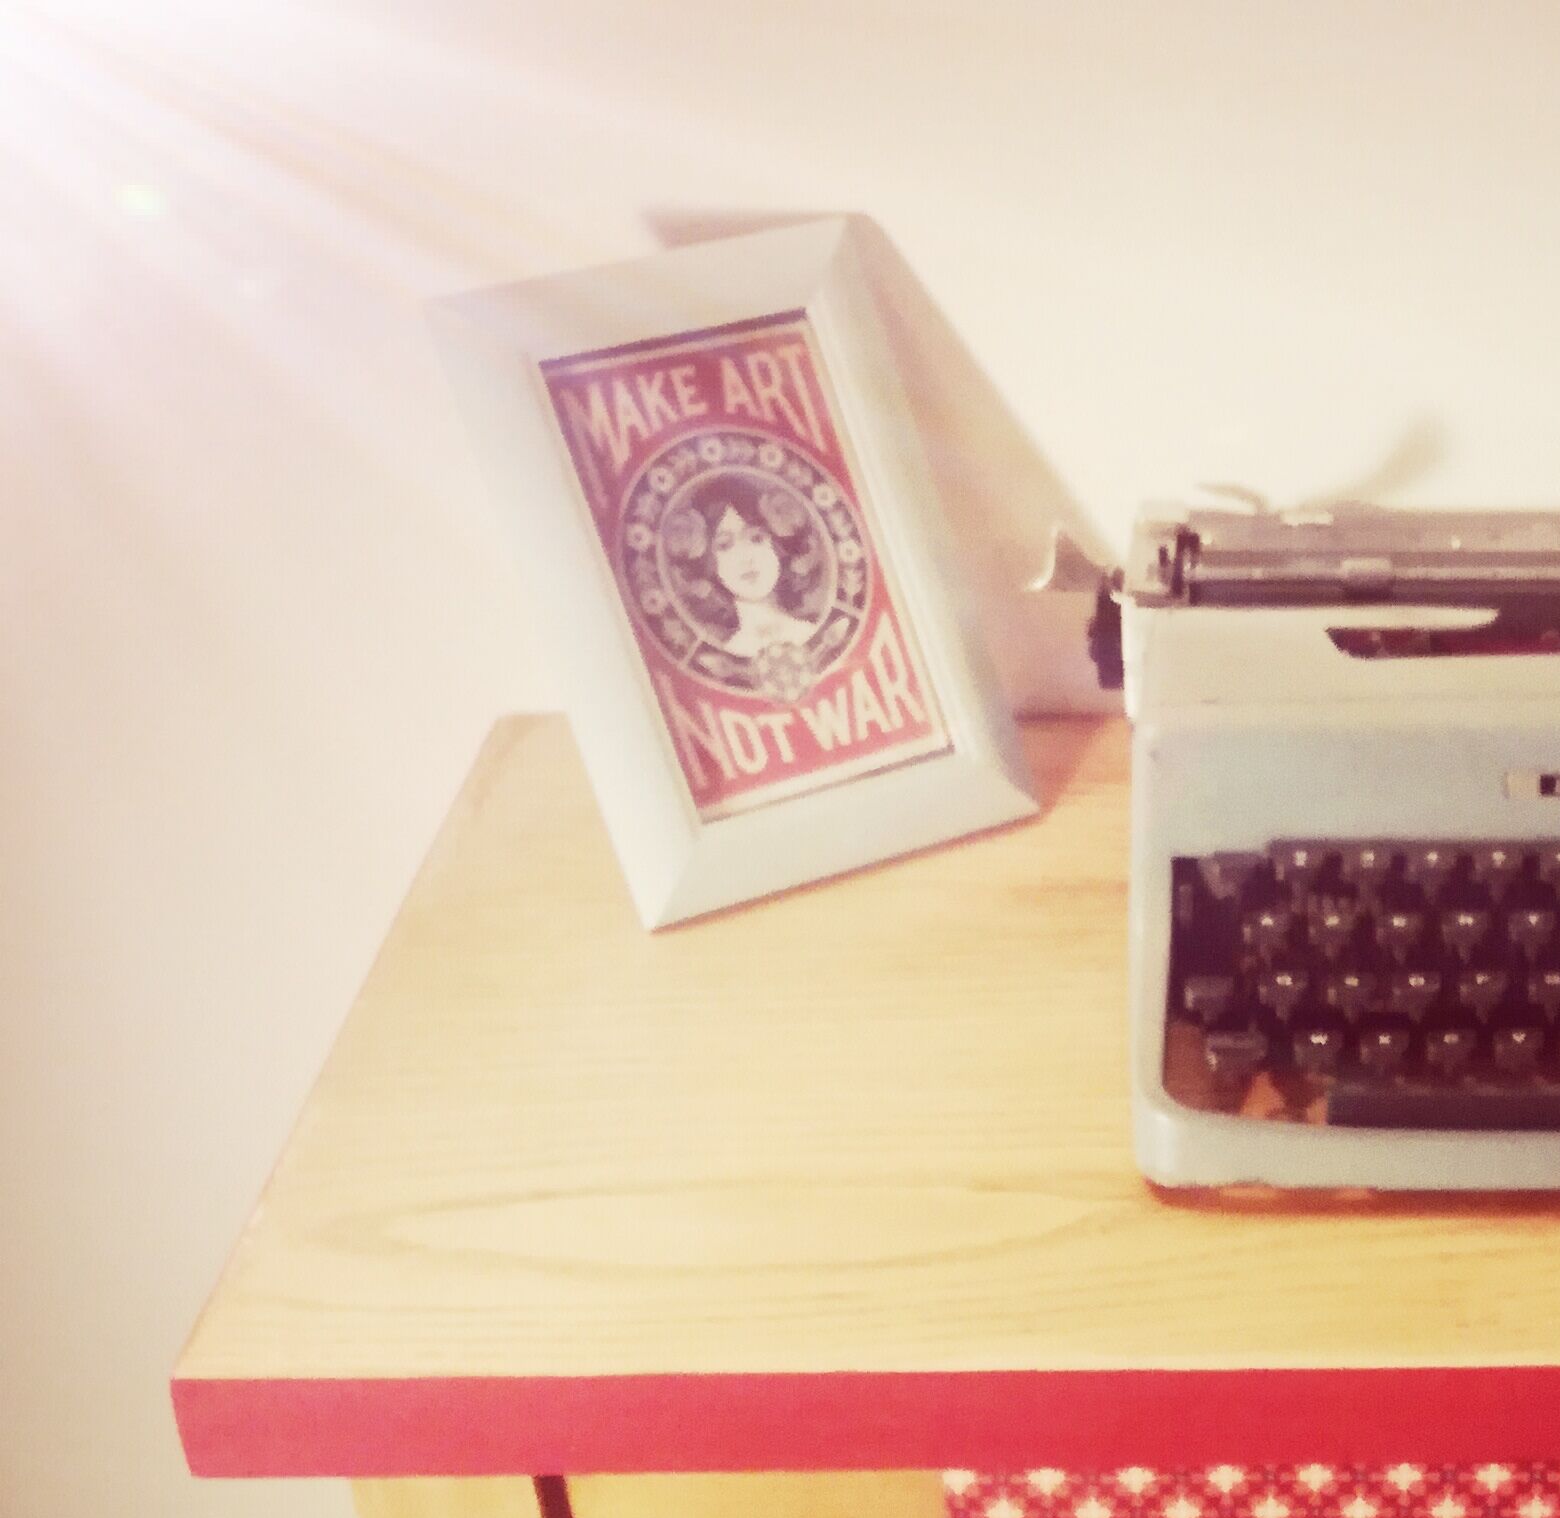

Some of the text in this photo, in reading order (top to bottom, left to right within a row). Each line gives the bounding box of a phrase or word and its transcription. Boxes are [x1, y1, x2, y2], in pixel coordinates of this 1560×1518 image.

[560, 345, 827, 504] MAKE ART
[660, 613, 930, 785] NOT WAR
